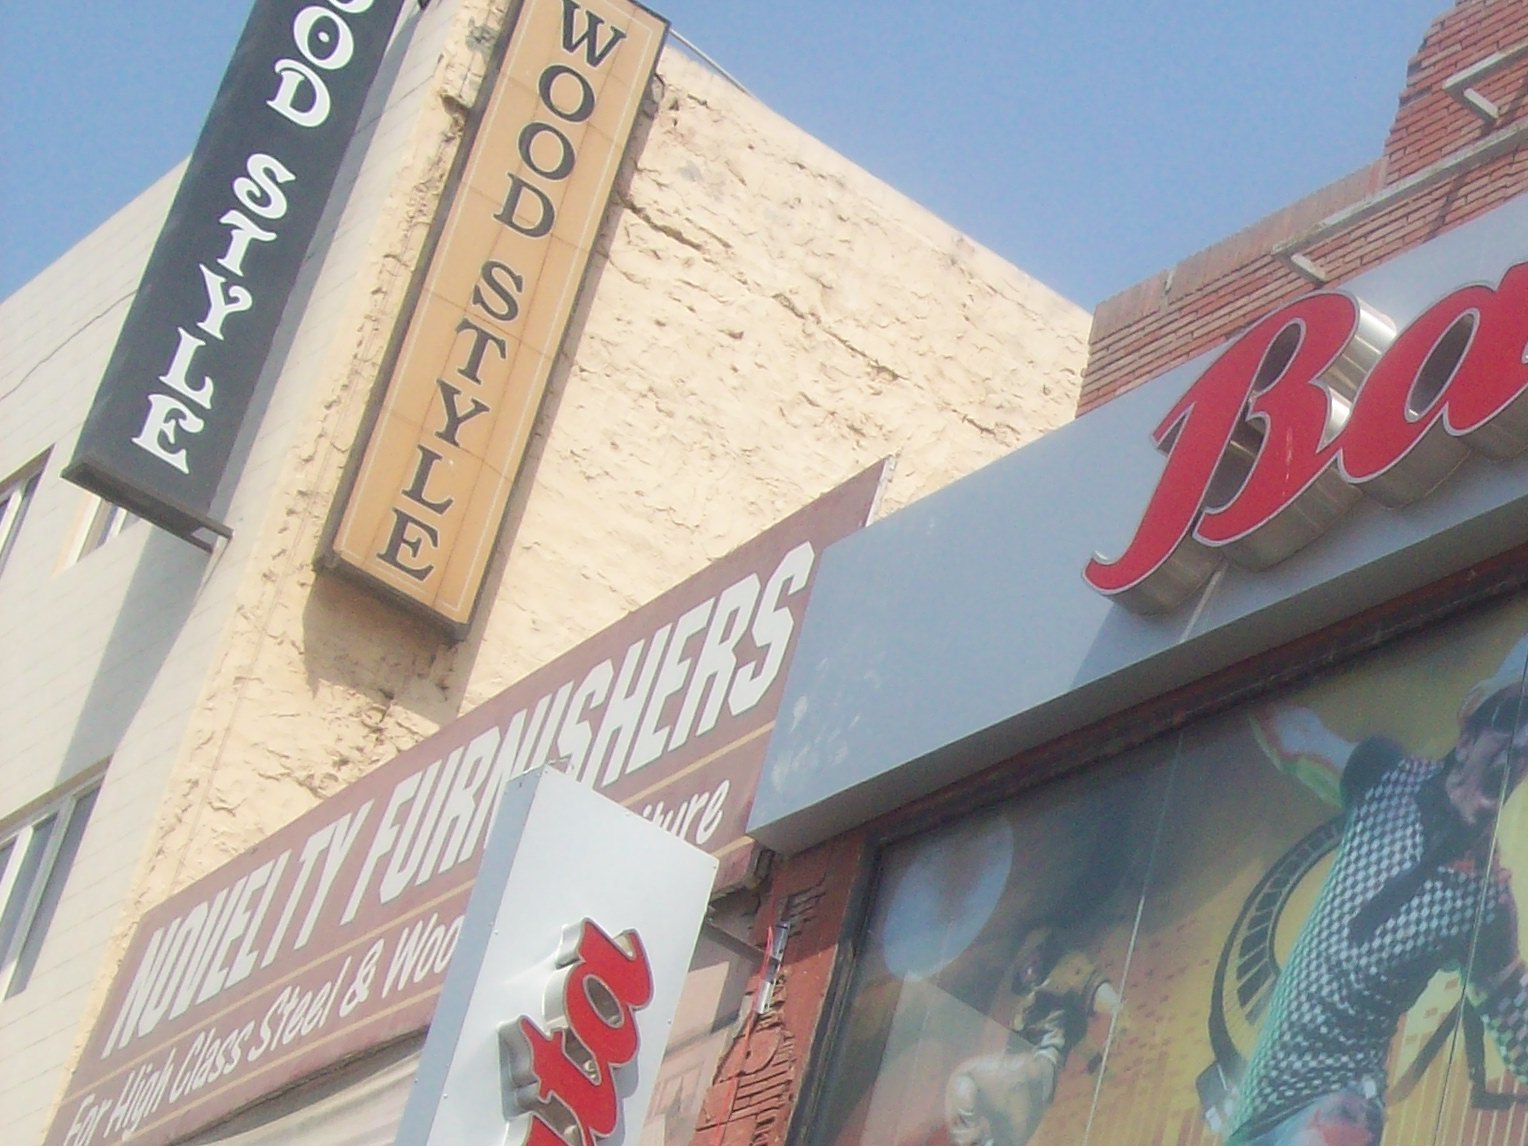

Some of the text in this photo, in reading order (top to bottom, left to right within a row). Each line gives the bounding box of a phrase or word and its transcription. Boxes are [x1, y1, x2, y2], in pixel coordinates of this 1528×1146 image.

[132, 0, 376, 474] OD STYLE
[376, 0, 626, 582] WOOD STYLE
[101, 540, 816, 1060] NOVELTY FURNISHERS
[103, 1047, 177, 1142] High
[169, 1020, 256, 1104] Class
[247, 955, 353, 1062] Steel
[338, 938, 386, 1019] &
